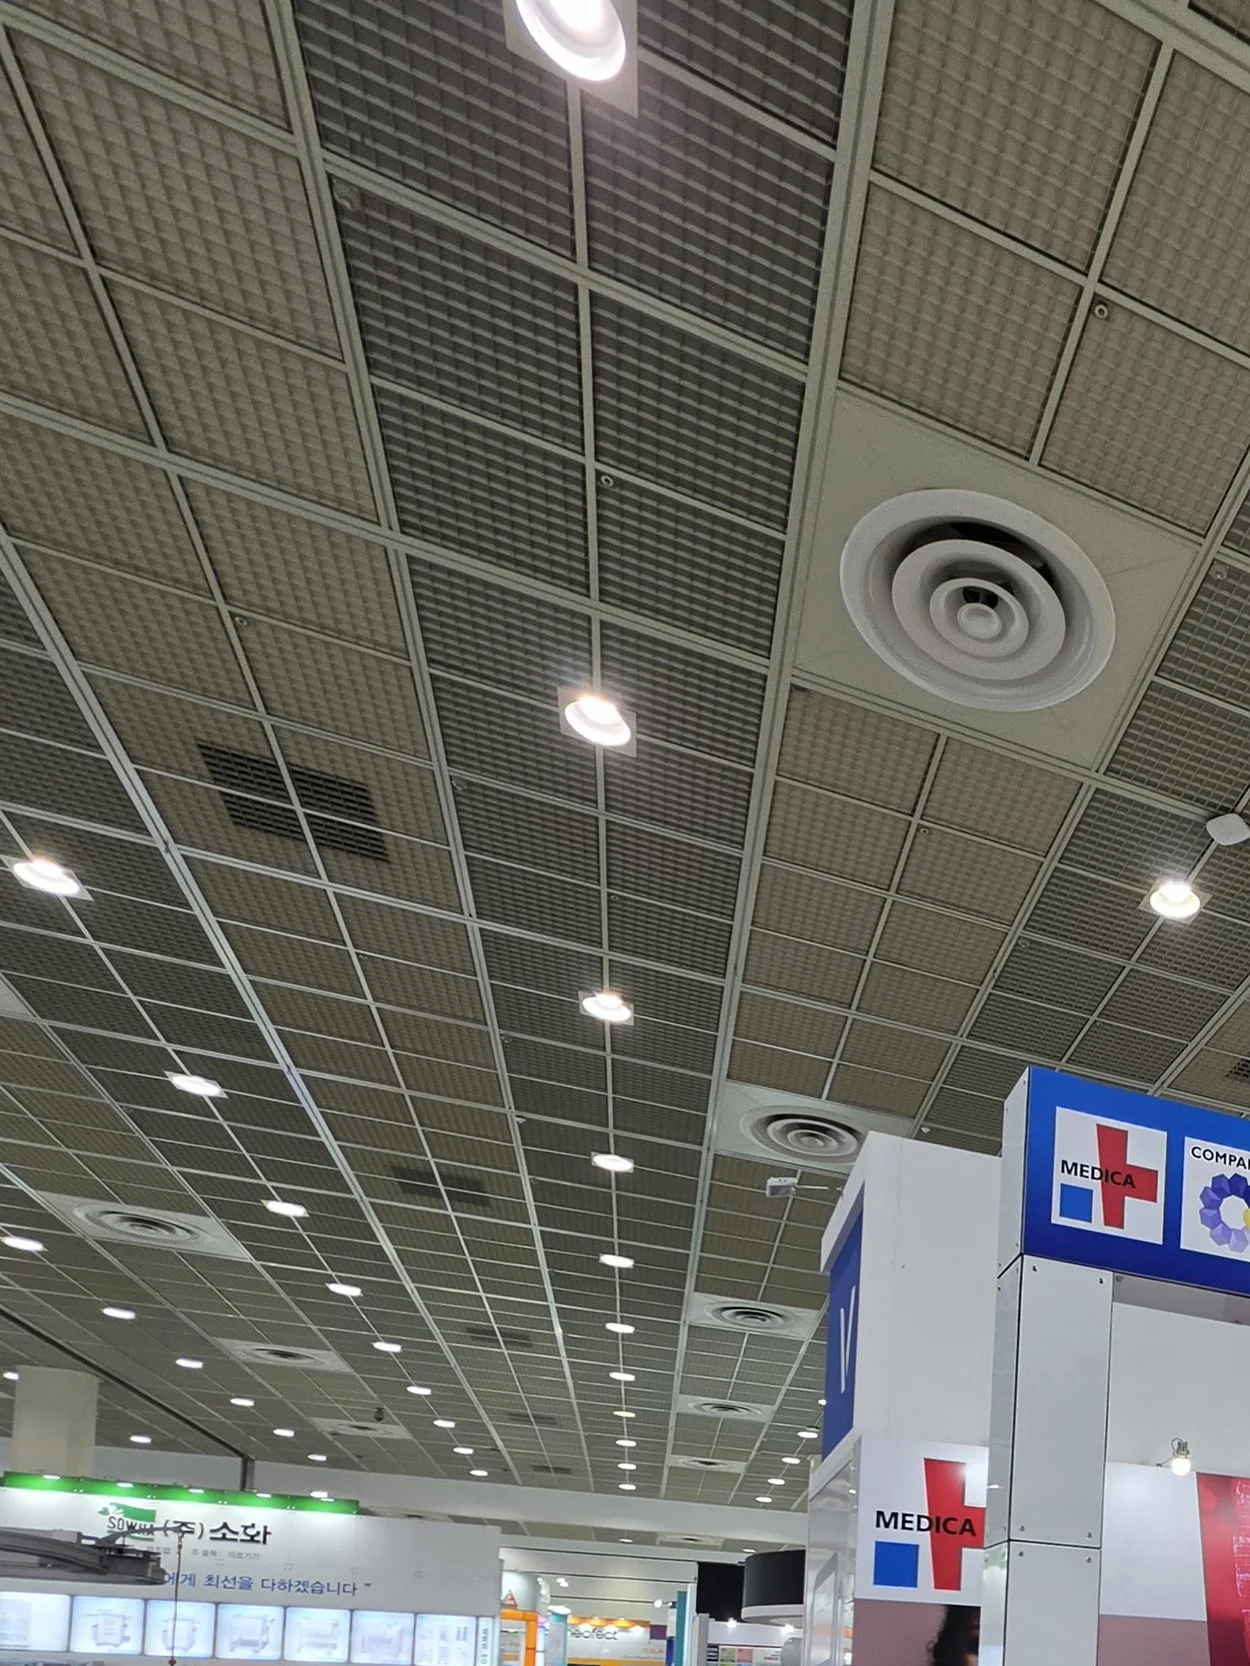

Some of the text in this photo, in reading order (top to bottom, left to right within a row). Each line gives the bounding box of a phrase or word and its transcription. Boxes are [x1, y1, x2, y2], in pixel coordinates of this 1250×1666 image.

[1061, 1160, 1136, 1189] MEDICA
[875, 1510, 977, 1537] MEDICA
[203, 1574, 254, 1590] 최선을
[261, 1578, 358, 1596] 다하겠습니다
